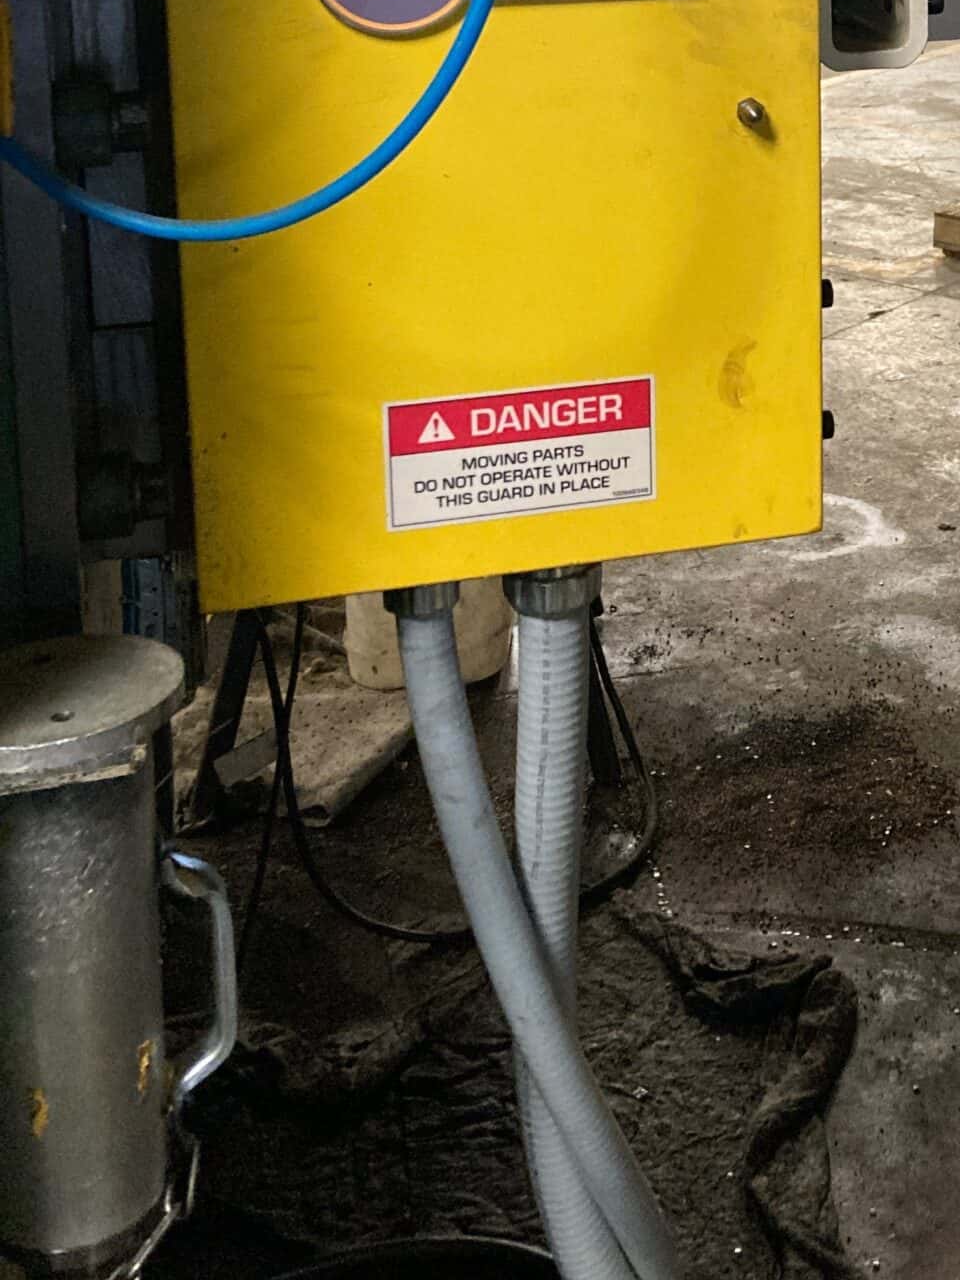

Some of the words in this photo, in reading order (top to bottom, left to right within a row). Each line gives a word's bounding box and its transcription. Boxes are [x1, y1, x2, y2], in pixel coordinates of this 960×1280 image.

[471, 393, 623, 437] DANGER
[414, 479, 438, 494] DO
[442, 474, 477, 491] NOT
[480, 466, 553, 486] OPERATE
[556, 456, 631, 477] WITHOUT
[461, 450, 528, 471] MOVING
[532, 444, 585, 462] PARTS
[436, 492, 473, 509] THIS
[477, 485, 534, 504] GUARD
[539, 482, 556, 496] IN
[560, 476, 610, 494] PLACE
